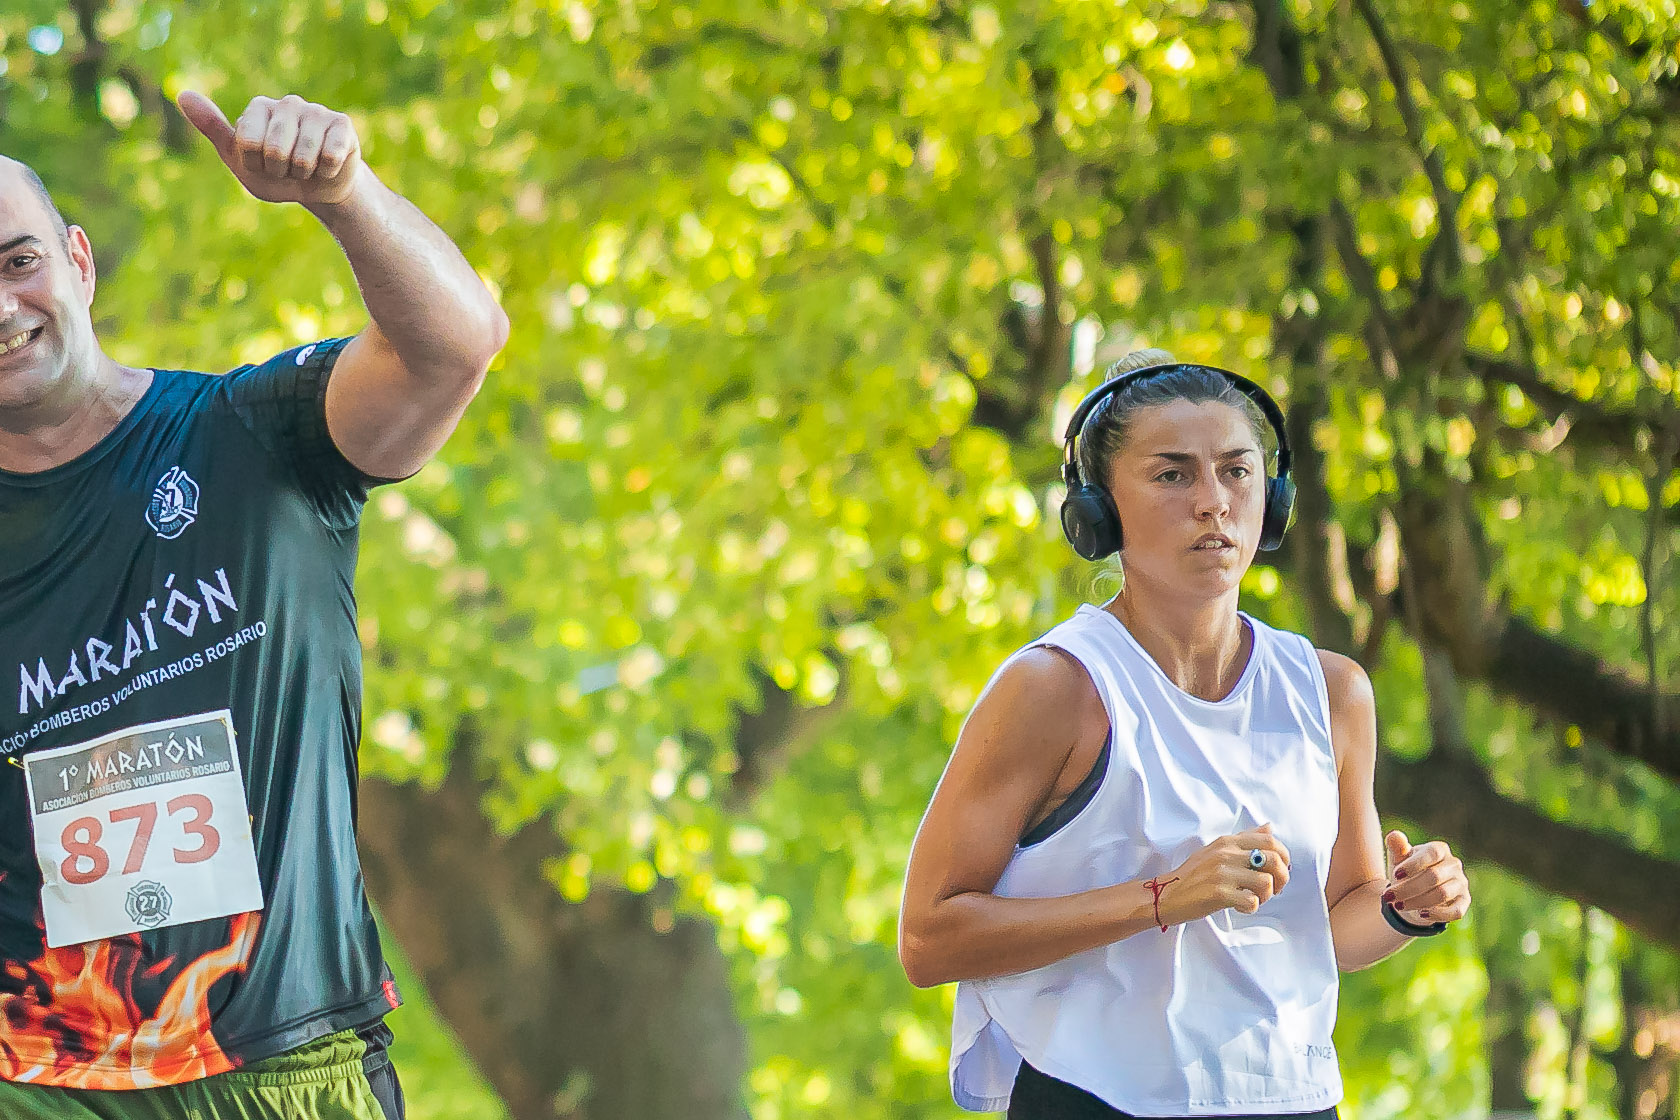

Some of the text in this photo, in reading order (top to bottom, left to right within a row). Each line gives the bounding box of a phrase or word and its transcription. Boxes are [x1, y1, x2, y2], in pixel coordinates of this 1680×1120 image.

[19, 568, 238, 714] MARATÓN
[29, 697, 110, 739] BOMBEROS
[112, 653, 204, 705] VOLUNTARIOS
[205, 621, 268, 663] ROSARIO
[86, 732, 205, 784] MARATÓN
[89, 780, 132, 800] BOMBEROS
[133, 767, 191, 787] VOLUNTARIOS
[192, 761, 231, 777] ROSARIO
[60, 793, 221, 885] 873
[139, 895, 158, 912] 27
